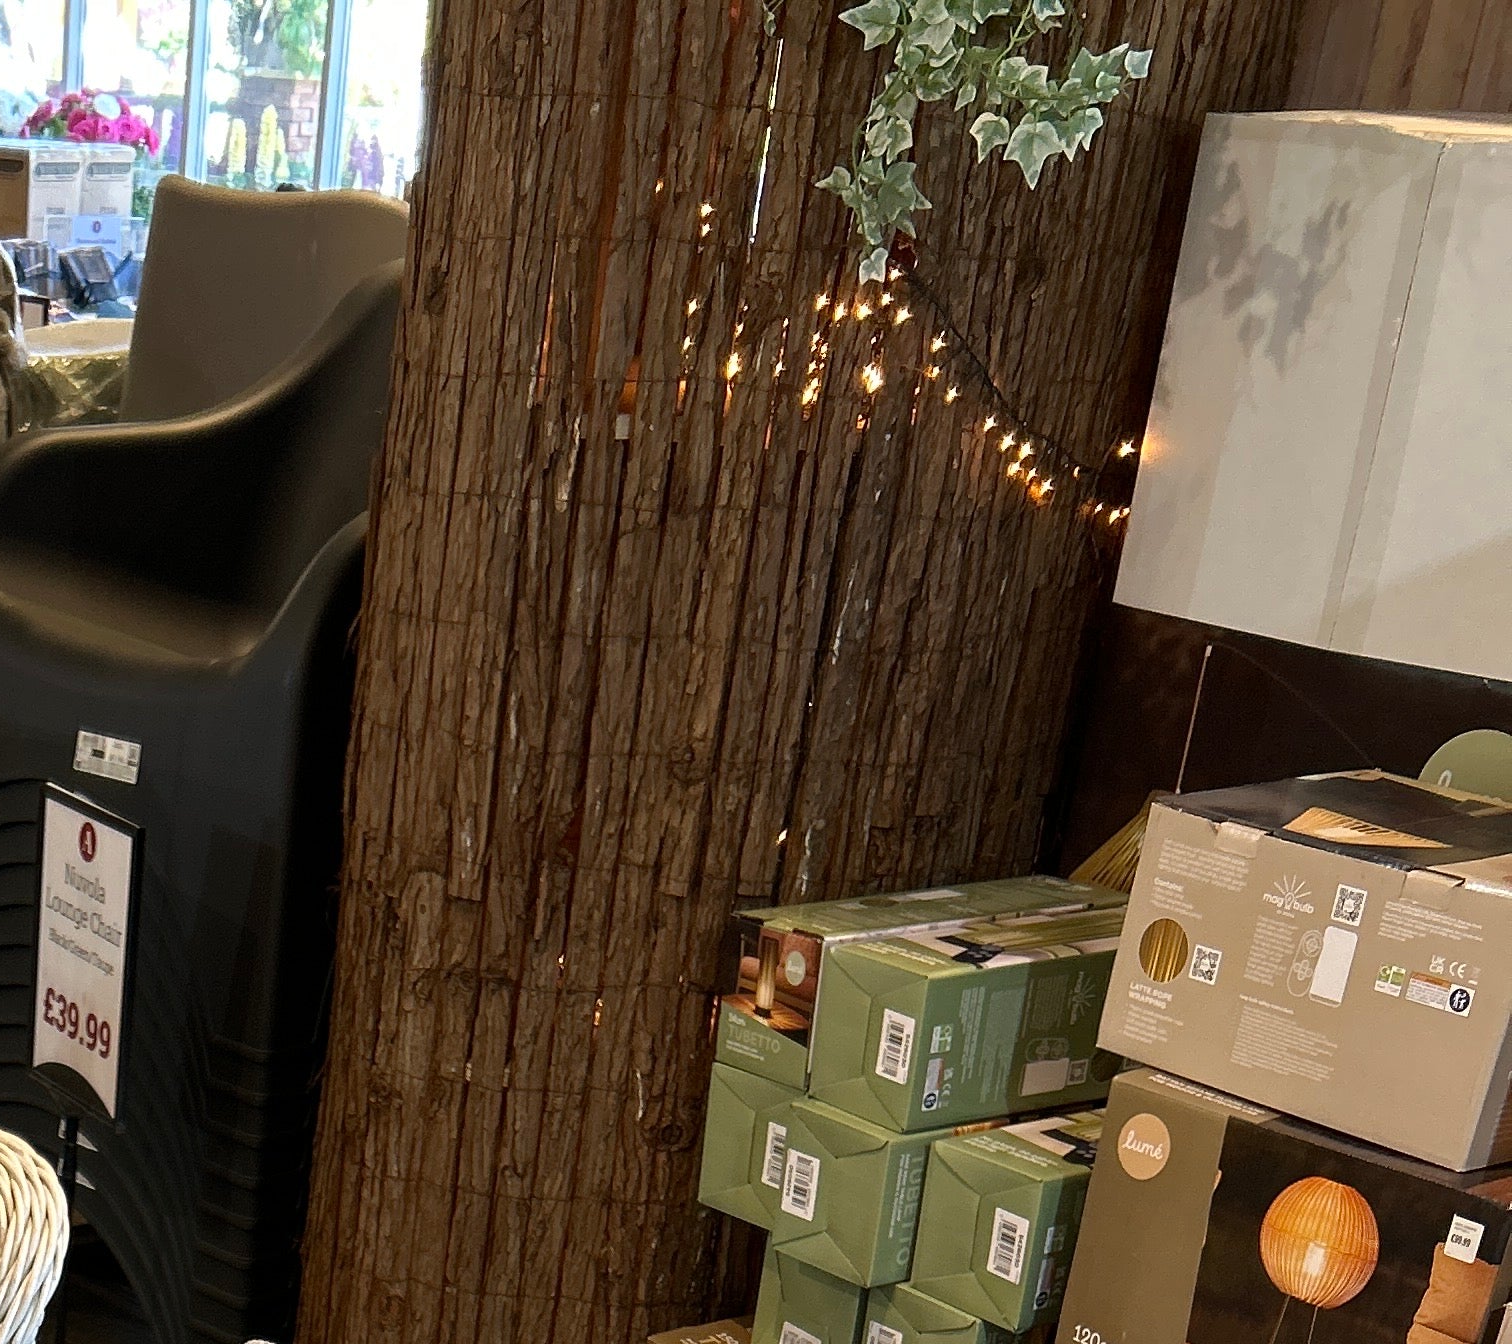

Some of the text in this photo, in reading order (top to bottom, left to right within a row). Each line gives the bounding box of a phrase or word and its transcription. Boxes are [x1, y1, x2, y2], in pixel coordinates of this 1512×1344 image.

[45, 885, 123, 948] Lounge Chair
[43, 987, 112, 1060] £39.99
[1121, 1129, 1164, 1160] lumé
